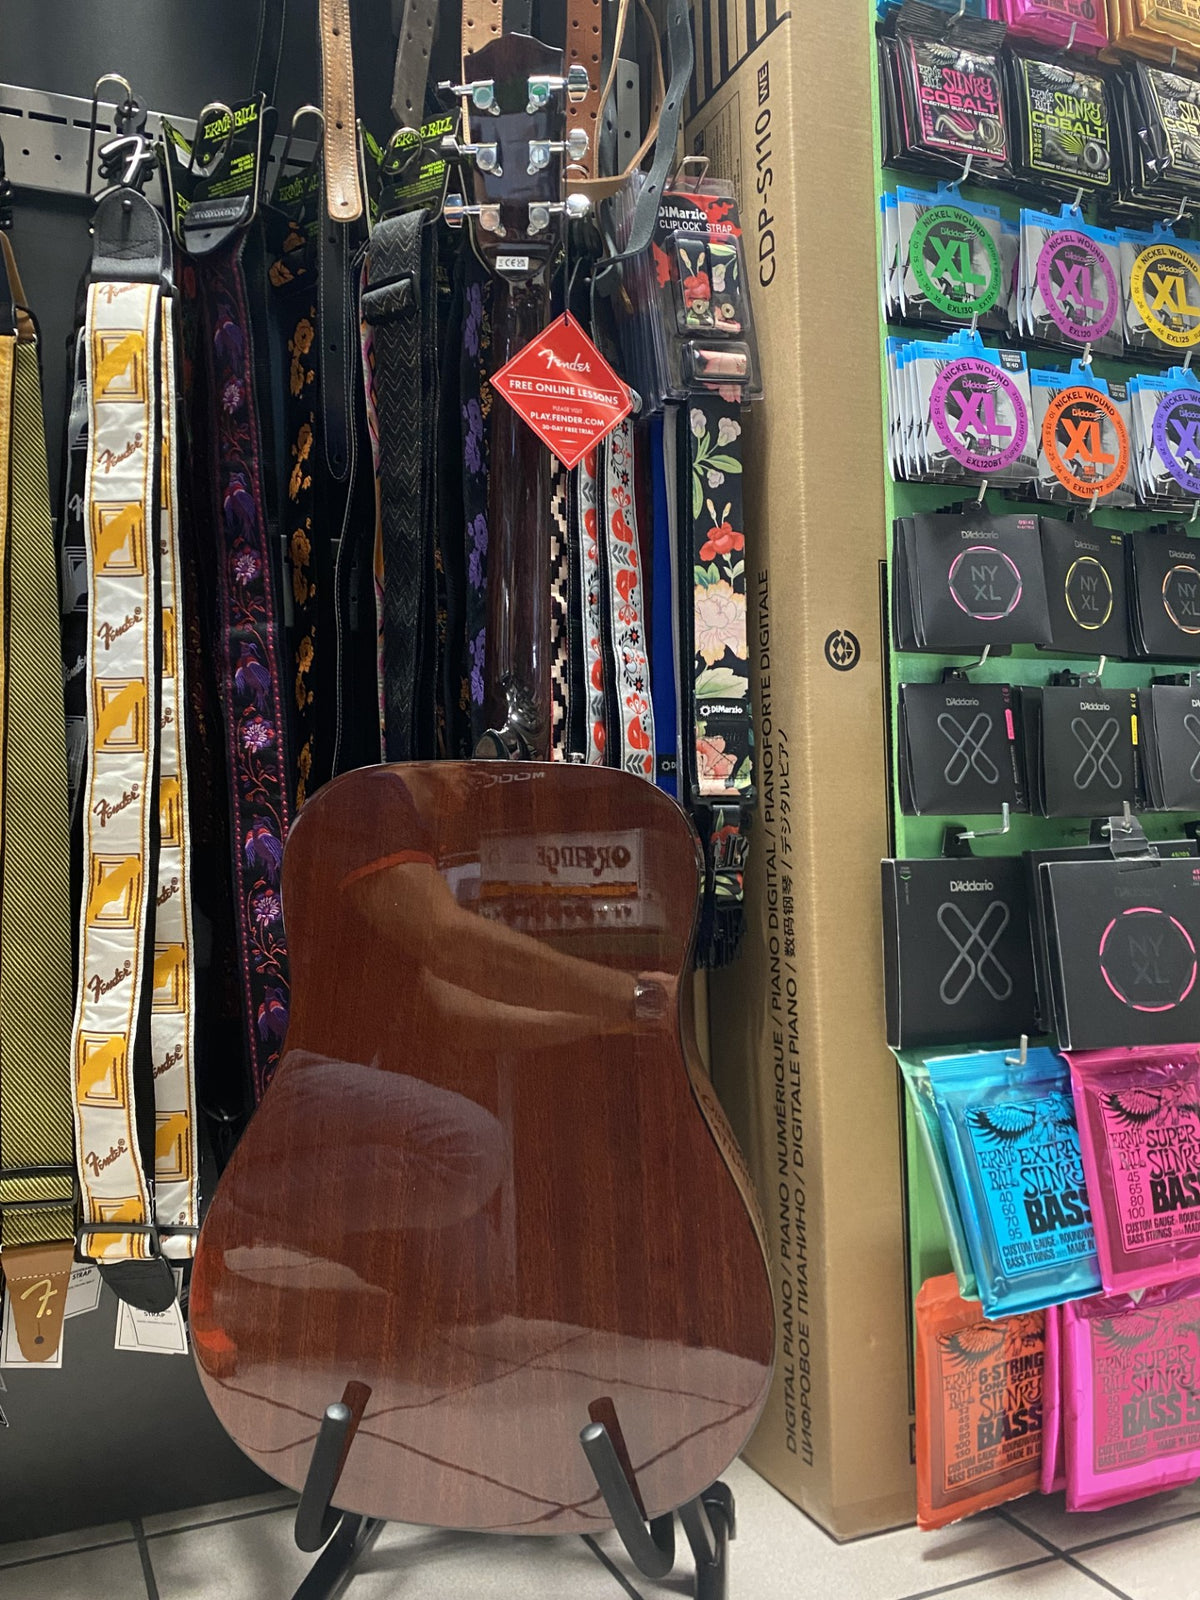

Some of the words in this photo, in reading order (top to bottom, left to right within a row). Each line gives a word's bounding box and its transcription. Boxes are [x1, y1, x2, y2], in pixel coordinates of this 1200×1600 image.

[759, 66, 769, 103] WE
[942, 68, 993, 100] SLINKY
[921, 87, 997, 114] COBALT
[1054, 92, 1102, 126] SLINKY
[235, 103, 258, 126] BALL
[1032, 110, 1106, 139] COBALT
[394, 126, 427, 148] ERNE
[427, 116, 453, 137] BALL
[755, 108, 776, 288] CDP-S110
[658, 205, 708, 221] DiMarzio
[922, 210, 952, 228] NICKEL
[954, 212, 986, 238] WOUND
[659, 219, 700, 231] CLIPLOCK
[706, 223, 733, 233] STRAP
[928, 236, 986, 286] XL
[1049, 235, 1075, 251] NICKEL
[1077, 236, 1105, 263] WOUND
[1141, 248, 1167, 264] NICKEL
[1169, 249, 1198, 273] WOUND
[1054, 259, 1104, 310] XL
[1146, 272, 1200, 316] XL
[947, 303, 973, 314] EXL130
[1069, 327, 1091, 338] EXL120
[1167, 333, 1190, 343] EXL125
[537, 348, 591, 373] Fender
[943, 362, 973, 383] NICKEL
[975, 363, 1009, 387] WOUND
[509, 380, 533, 391] FREE
[537, 382, 575, 396] ONLINE
[578, 388, 619, 406] LESSONS
[1055, 391, 1083, 409] NICKEL
[1085, 392, 1115, 416] WOUND
[1163, 394, 1188, 412] NICKEL
[530, 412, 605, 426] PLAY.FENDER.COM
[552, 405, 570, 413] PLEASE
[570, 406, 583, 414] VISIT
[950, 390, 1012, 436] XL
[542, 424, 564, 432] 30-DAY
[564, 425, 578, 433] FREE
[578, 427, 594, 435] TRIAL
[1060, 418, 1114, 464] XL
[97, 438, 143, 474] Fender
[966, 456, 1002, 468] EXL120BT
[961, 531, 999, 540] D'Addario
[1169, 550, 1196, 560] D'Addario
[972, 566, 998, 581] NY
[1081, 576, 1098, 592] NY
[973, 584, 1002, 600] XL
[1178, 582, 1197, 597] NY
[1081, 596, 1099, 611] XL
[1181, 600, 1200, 615] XL
[758, 569, 771, 670] DIGITALE
[97, 614, 143, 651] Fender
[711, 705, 743, 714] DiMarzio
[946, 698, 979, 706] D'Addario
[1080, 702, 1110, 711] D'Addario
[760, 676, 775, 823] PIANOFORTE
[778, 728, 792, 855] デジタルピアノ
[93, 790, 140, 828] Fender
[766, 838, 780, 928] DIGITAL
[950, 880, 994, 892] D'Addario
[782, 875, 795, 957] 数码钢琴
[1128, 935, 1164, 957] NY
[87, 967, 132, 1004] Fender
[768, 936, 782, 1010] PIANO
[1134, 962, 1169, 984] XL
[786, 978, 799, 1053] PIANO
[772, 1030, 789, 1175] NUMÉRIQUE
[790, 1060, 804, 1168] DIGITALE
[1109, 1127, 1145, 1149] ERNIE
[1146, 1124, 1200, 1148] SUPER
[86, 1144, 128, 1178] Fender
[978, 1142, 1018, 1168] ERNIE
[1018, 1138, 1082, 1166] EXTRA
[1120, 1149, 1146, 1170] BALL
[988, 1167, 1019, 1190] BALL
[1020, 1158, 1086, 1199] SLINKY
[1128, 1171, 1140, 1182] 45
[1129, 1183, 1142, 1195] 65
[1000, 1191, 1013, 1202] 40
[1130, 1195, 1144, 1207] 80
[1150, 1172, 1200, 1214] BAS
[779, 1183, 791, 1260] PIANO
[1002, 1203, 1016, 1215] 60
[1006, 1216, 1019, 1227] 70
[1128, 1207, 1145, 1219] 100
[1008, 1228, 1022, 1240] 95
[1125, 1219, 1153, 1234] CUSTOM
[1154, 1215, 1175, 1228] GAUGE
[1126, 1233, 1145, 1246] BASS
[1146, 1227, 1172, 1240] STRINGS
[795, 1188, 808, 1315] ПИАНИНО
[1002, 1241, 1033, 1256] CUSTOM
[1034, 1236, 1056, 1250] GAUGE
[1005, 1255, 1025, 1269] BASS
[1026, 1248, 1055, 1264] STRINGS
[1066, 1241, 1087, 1253] MADE
[72, 1270, 92, 1280] STRAP
[782, 1274, 794, 1357] PIANO
[1133, 1344, 1196, 1372] SUPER
[943, 1368, 977, 1392] ERNIE
[979, 1380, 1007, 1393] LONG
[1131, 1359, 1200, 1402] SLINKY
[798, 1322, 814, 1467] ЦИФРОВОЕ
[978, 1377, 1042, 1422] SLINKY
[786, 1364, 796, 1454] DIGITAL
[1122, 1394, 1182, 1439] BASS
[977, 1402, 1043, 1452] BASS
[948, 1456, 976, 1474] CUSTOM
[966, 1459, 994, 1478] STRINGS
[1007, 1448, 1024, 1460] MADE
[1026, 1445, 1033, 1456] IN
